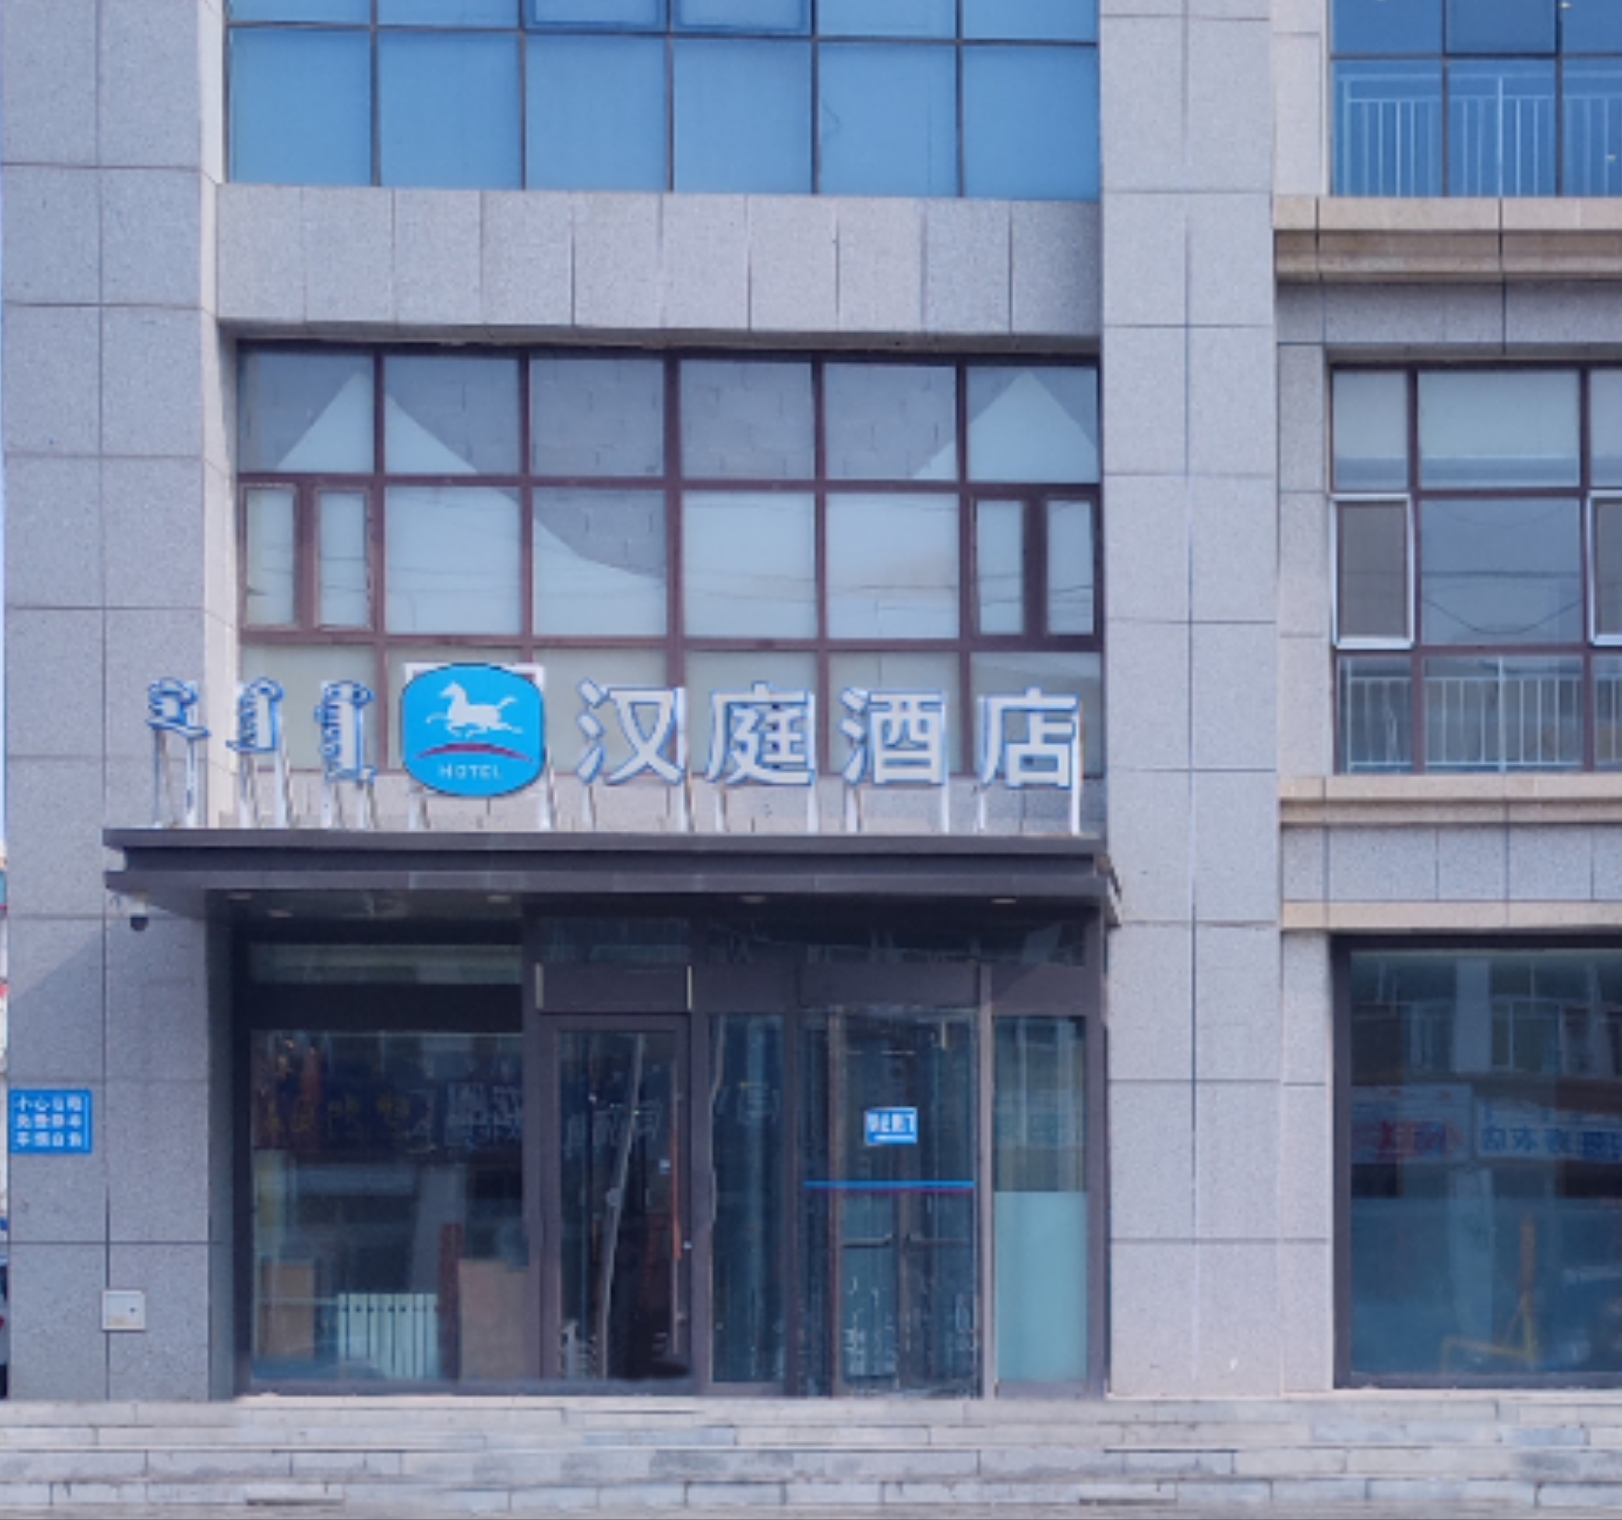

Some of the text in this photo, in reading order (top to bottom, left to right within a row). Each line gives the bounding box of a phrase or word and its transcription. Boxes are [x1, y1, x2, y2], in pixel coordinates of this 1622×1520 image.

[577, 680, 1081, 789] 汉庭酒店
[439, 763, 503, 780] HOTEL
